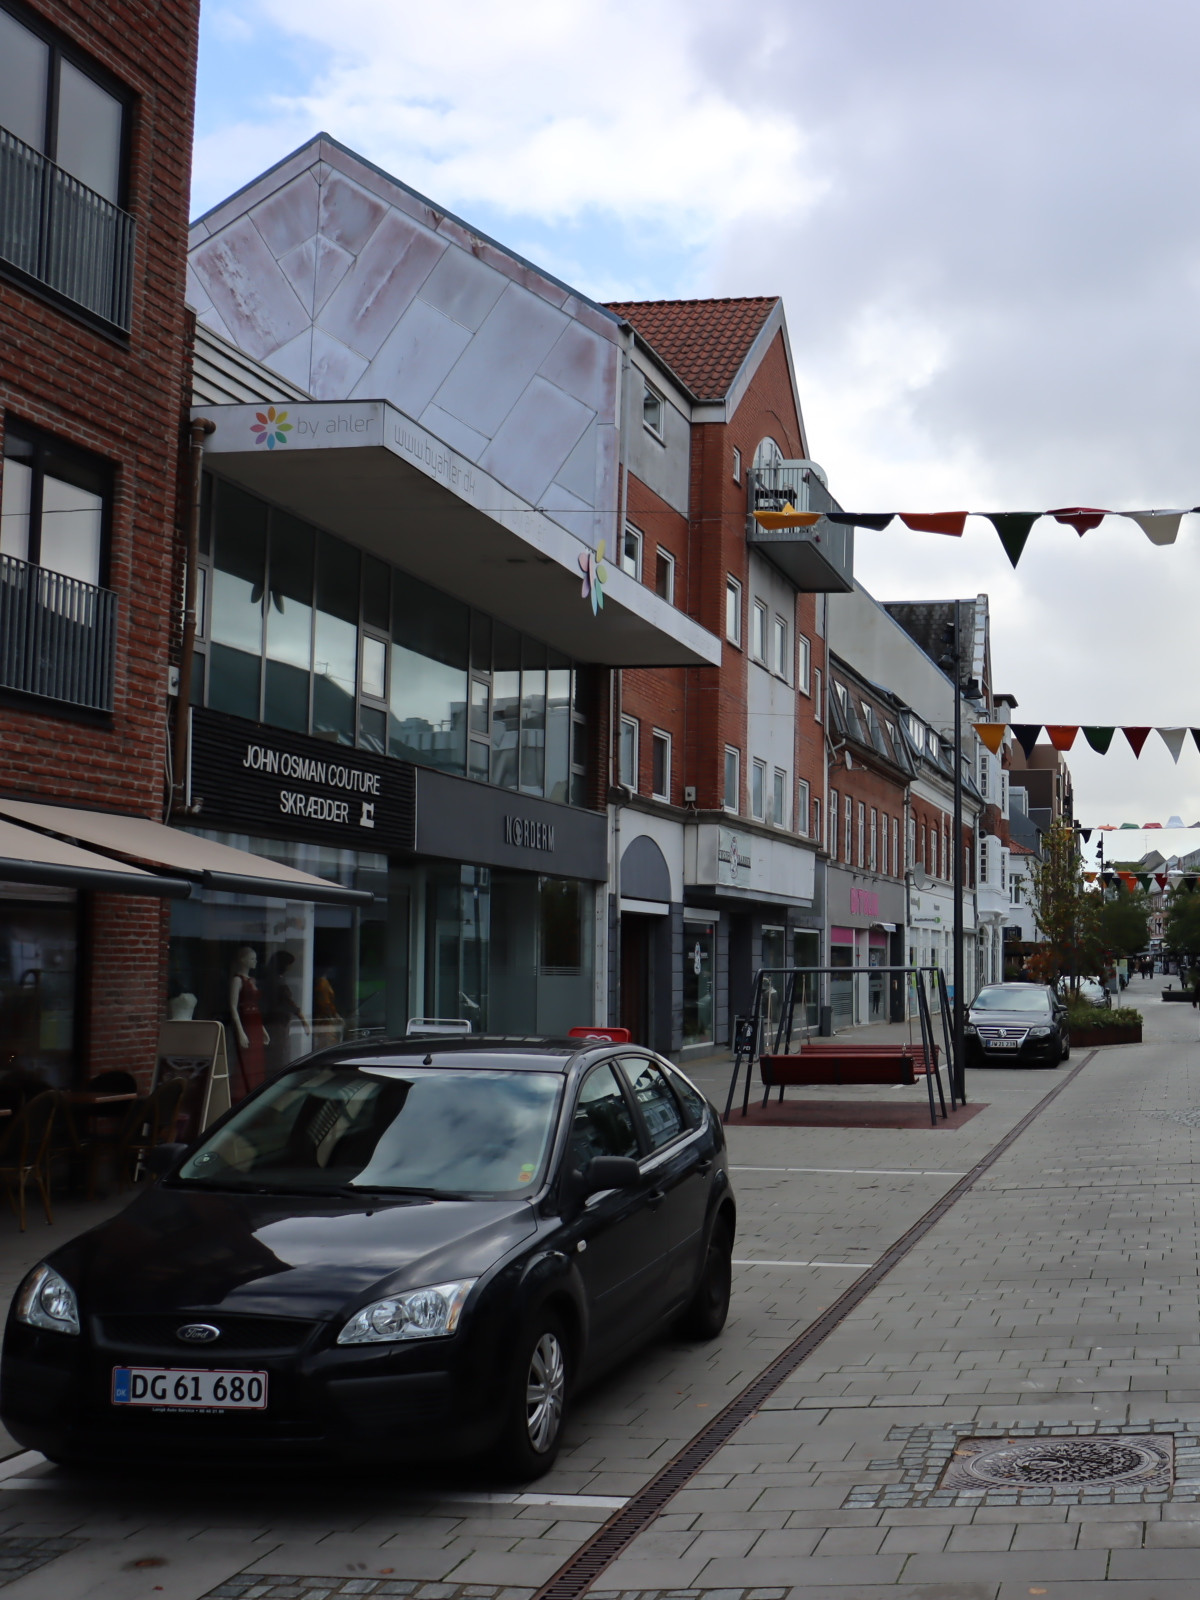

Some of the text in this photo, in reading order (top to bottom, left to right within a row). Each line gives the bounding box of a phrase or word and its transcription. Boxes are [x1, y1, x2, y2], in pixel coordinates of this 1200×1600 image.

[297, 414, 374, 438] by ahler
[243, 745, 381, 795] JOHN OSMAN COUTURE
[280, 790, 349, 823] SKRÆDDER
[185, 1328, 209, 1339] Ford
[116, 1389, 127, 1397] DK
[132, 1374, 263, 1402] DG 61 680
